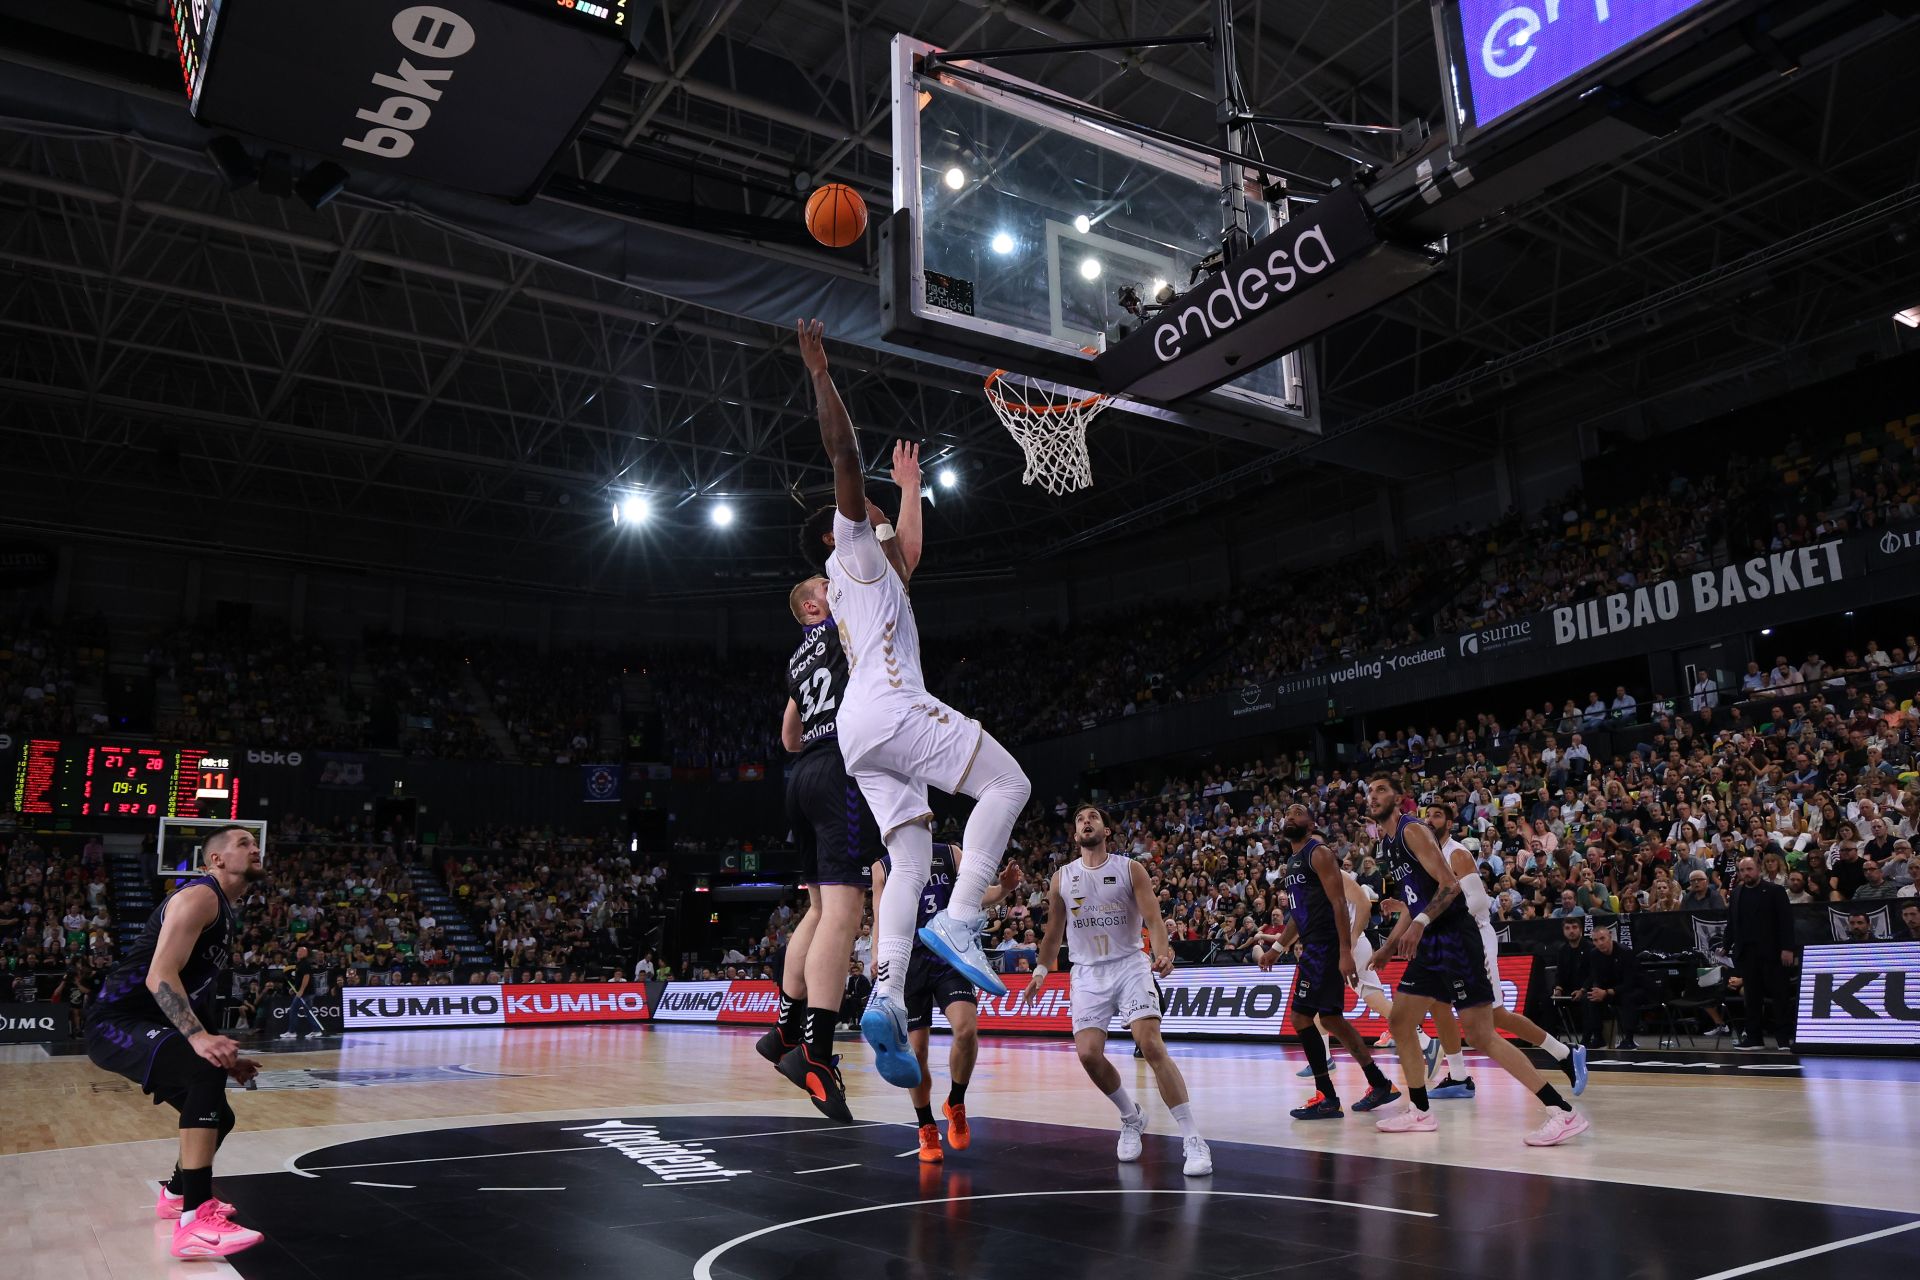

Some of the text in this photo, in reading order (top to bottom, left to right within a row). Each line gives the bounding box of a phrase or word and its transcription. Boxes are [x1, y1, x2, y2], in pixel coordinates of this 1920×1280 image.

[614, 12, 625, 26] 2
[342, 57, 454, 159] bbk
[1154, 224, 1336, 362] endesa
[1553, 538, 1844, 645] BILBAO BASKET
[1481, 621, 1531, 644] surne
[1399, 646, 1446, 668] Occident
[1331, 655, 1385, 684] vueling
[799, 667, 836, 723] 32
[105, 755, 163, 770] 27 28
[247, 750, 286, 765] bbk
[127, 767, 137, 777] 2
[203, 772, 225, 789] 11
[112, 781, 148, 795] 09:15
[724, 855, 736, 868] C
[924, 894, 938, 914] 3
[1083, 905, 1098, 913] SAN
[1077, 916, 1120, 929] BURGOS
[1093, 934, 1109, 956] 17
[348, 995, 499, 1017] KUMHO
[506, 992, 644, 1014] KUMHO
[660, 991, 723, 1011] KUMHO
[722, 991, 779, 1012] KUMH
[975, 989, 1071, 1017] KUMH
[9, 1017, 56, 1031] IMQ
